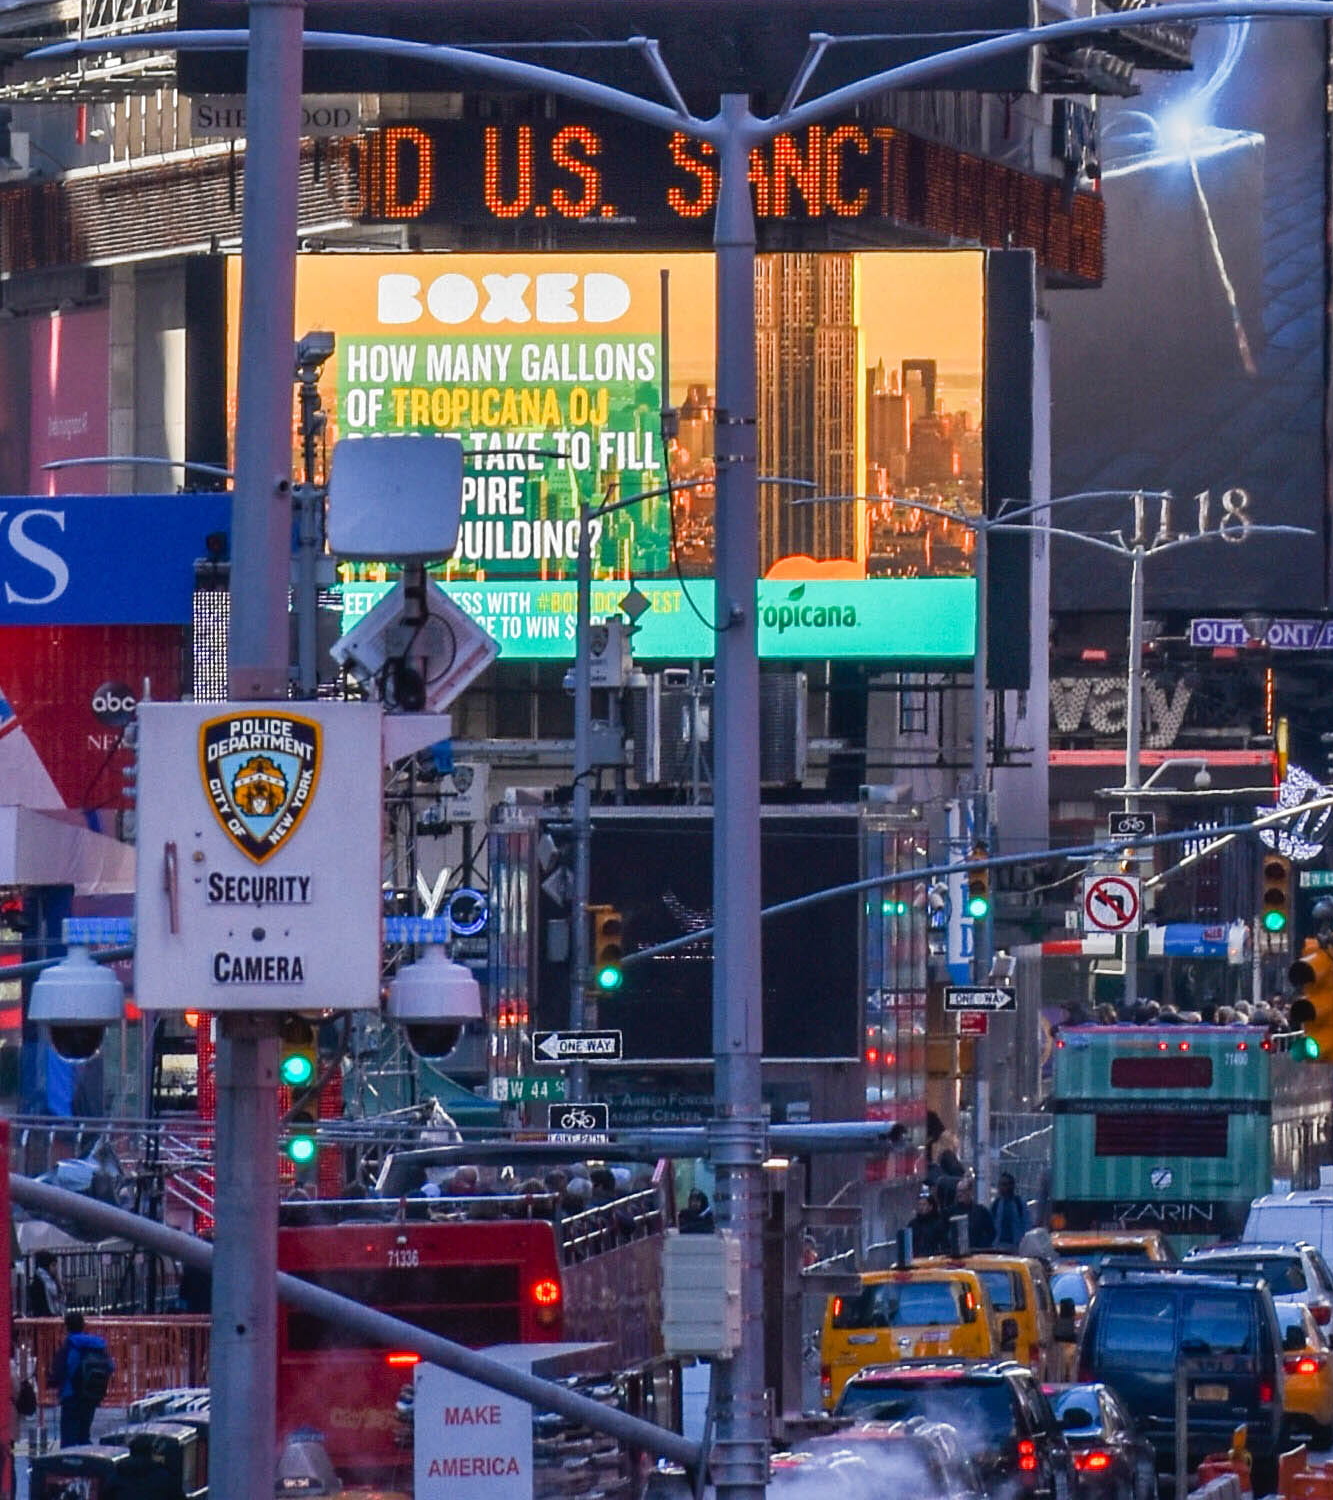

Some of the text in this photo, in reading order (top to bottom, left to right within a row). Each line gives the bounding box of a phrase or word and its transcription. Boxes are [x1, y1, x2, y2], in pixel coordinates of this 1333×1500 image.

[484, 125, 618, 220] U.S.
[378, 273, 631, 324] BOXED
[347, 342, 655, 382] HOW MANY GALLONS
[347, 387, 610, 427] OF TROPICANA OJ
[473, 432, 661, 470] TAKE TO FILL
[0, 509, 69, 605] S
[488, 591, 531, 614] WITH
[757, 598, 858, 633] ropicana
[502, 615, 520, 639] TO
[523, 615, 556, 639] WIN
[1197, 622, 1315, 647] OUTONT
[92, 691, 137, 713] abc
[229, 718, 293, 738] POLICE
[207, 732, 314, 762] DEPARTMENT
[209, 777, 247, 838] CITY OF
[267, 768, 315, 845] NEW YORK
[208, 872, 311, 903] SECURITY
[213, 952, 304, 983] CAMERA
[984, 993, 1005, 1004] WAY
[559, 1038, 611, 1053] ONE WAY
[509, 1081, 524, 1099] W
[530, 1081, 549, 1099] 44
[444, 1404, 502, 1425] MAKE
[428, 1457, 520, 1478] AMERICA
